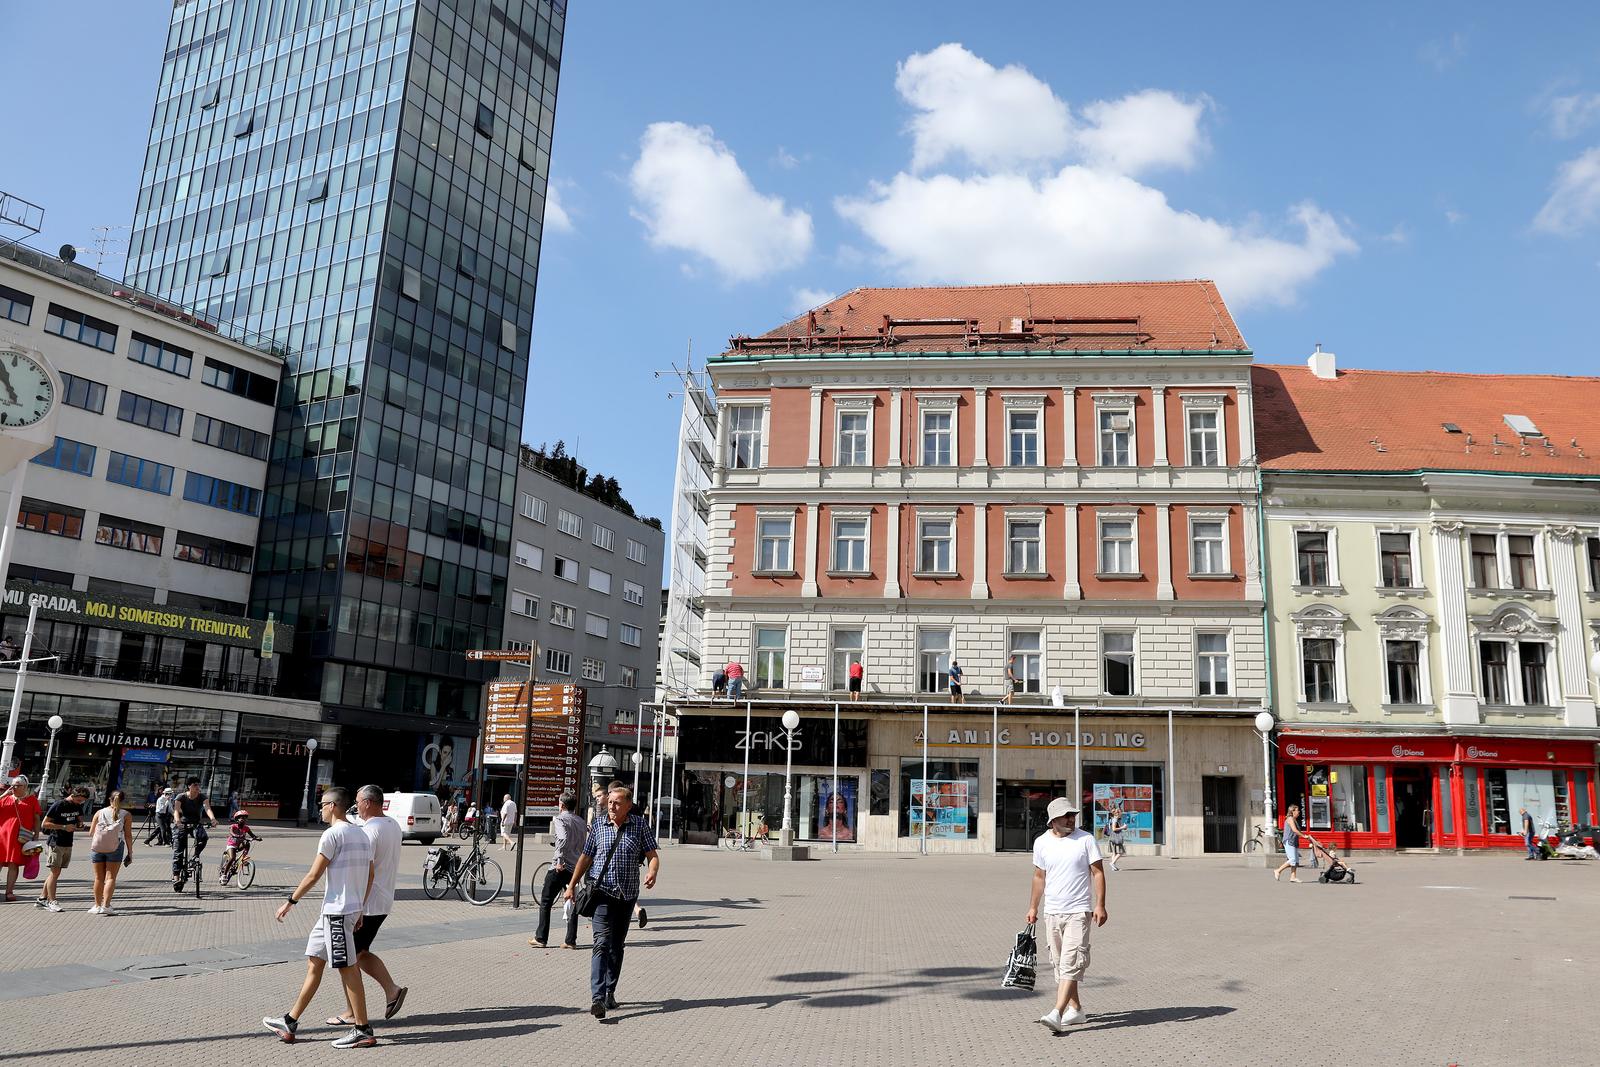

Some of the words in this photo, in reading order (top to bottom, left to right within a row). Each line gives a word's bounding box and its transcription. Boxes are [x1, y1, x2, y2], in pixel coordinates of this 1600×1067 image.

[28, 592, 81, 614] GRADA.
[85, 600, 117, 619] MOJ
[118, 607, 187, 630] SOMERSBY
[189, 617, 252, 640] TRENUTAK.
[89, 732, 149, 746] KNJIŽARA
[154, 738, 195, 750] LJEVAK
[735, 731, 803, 751] ZAKS
[1030, 731, 1146, 748] HOLDING
